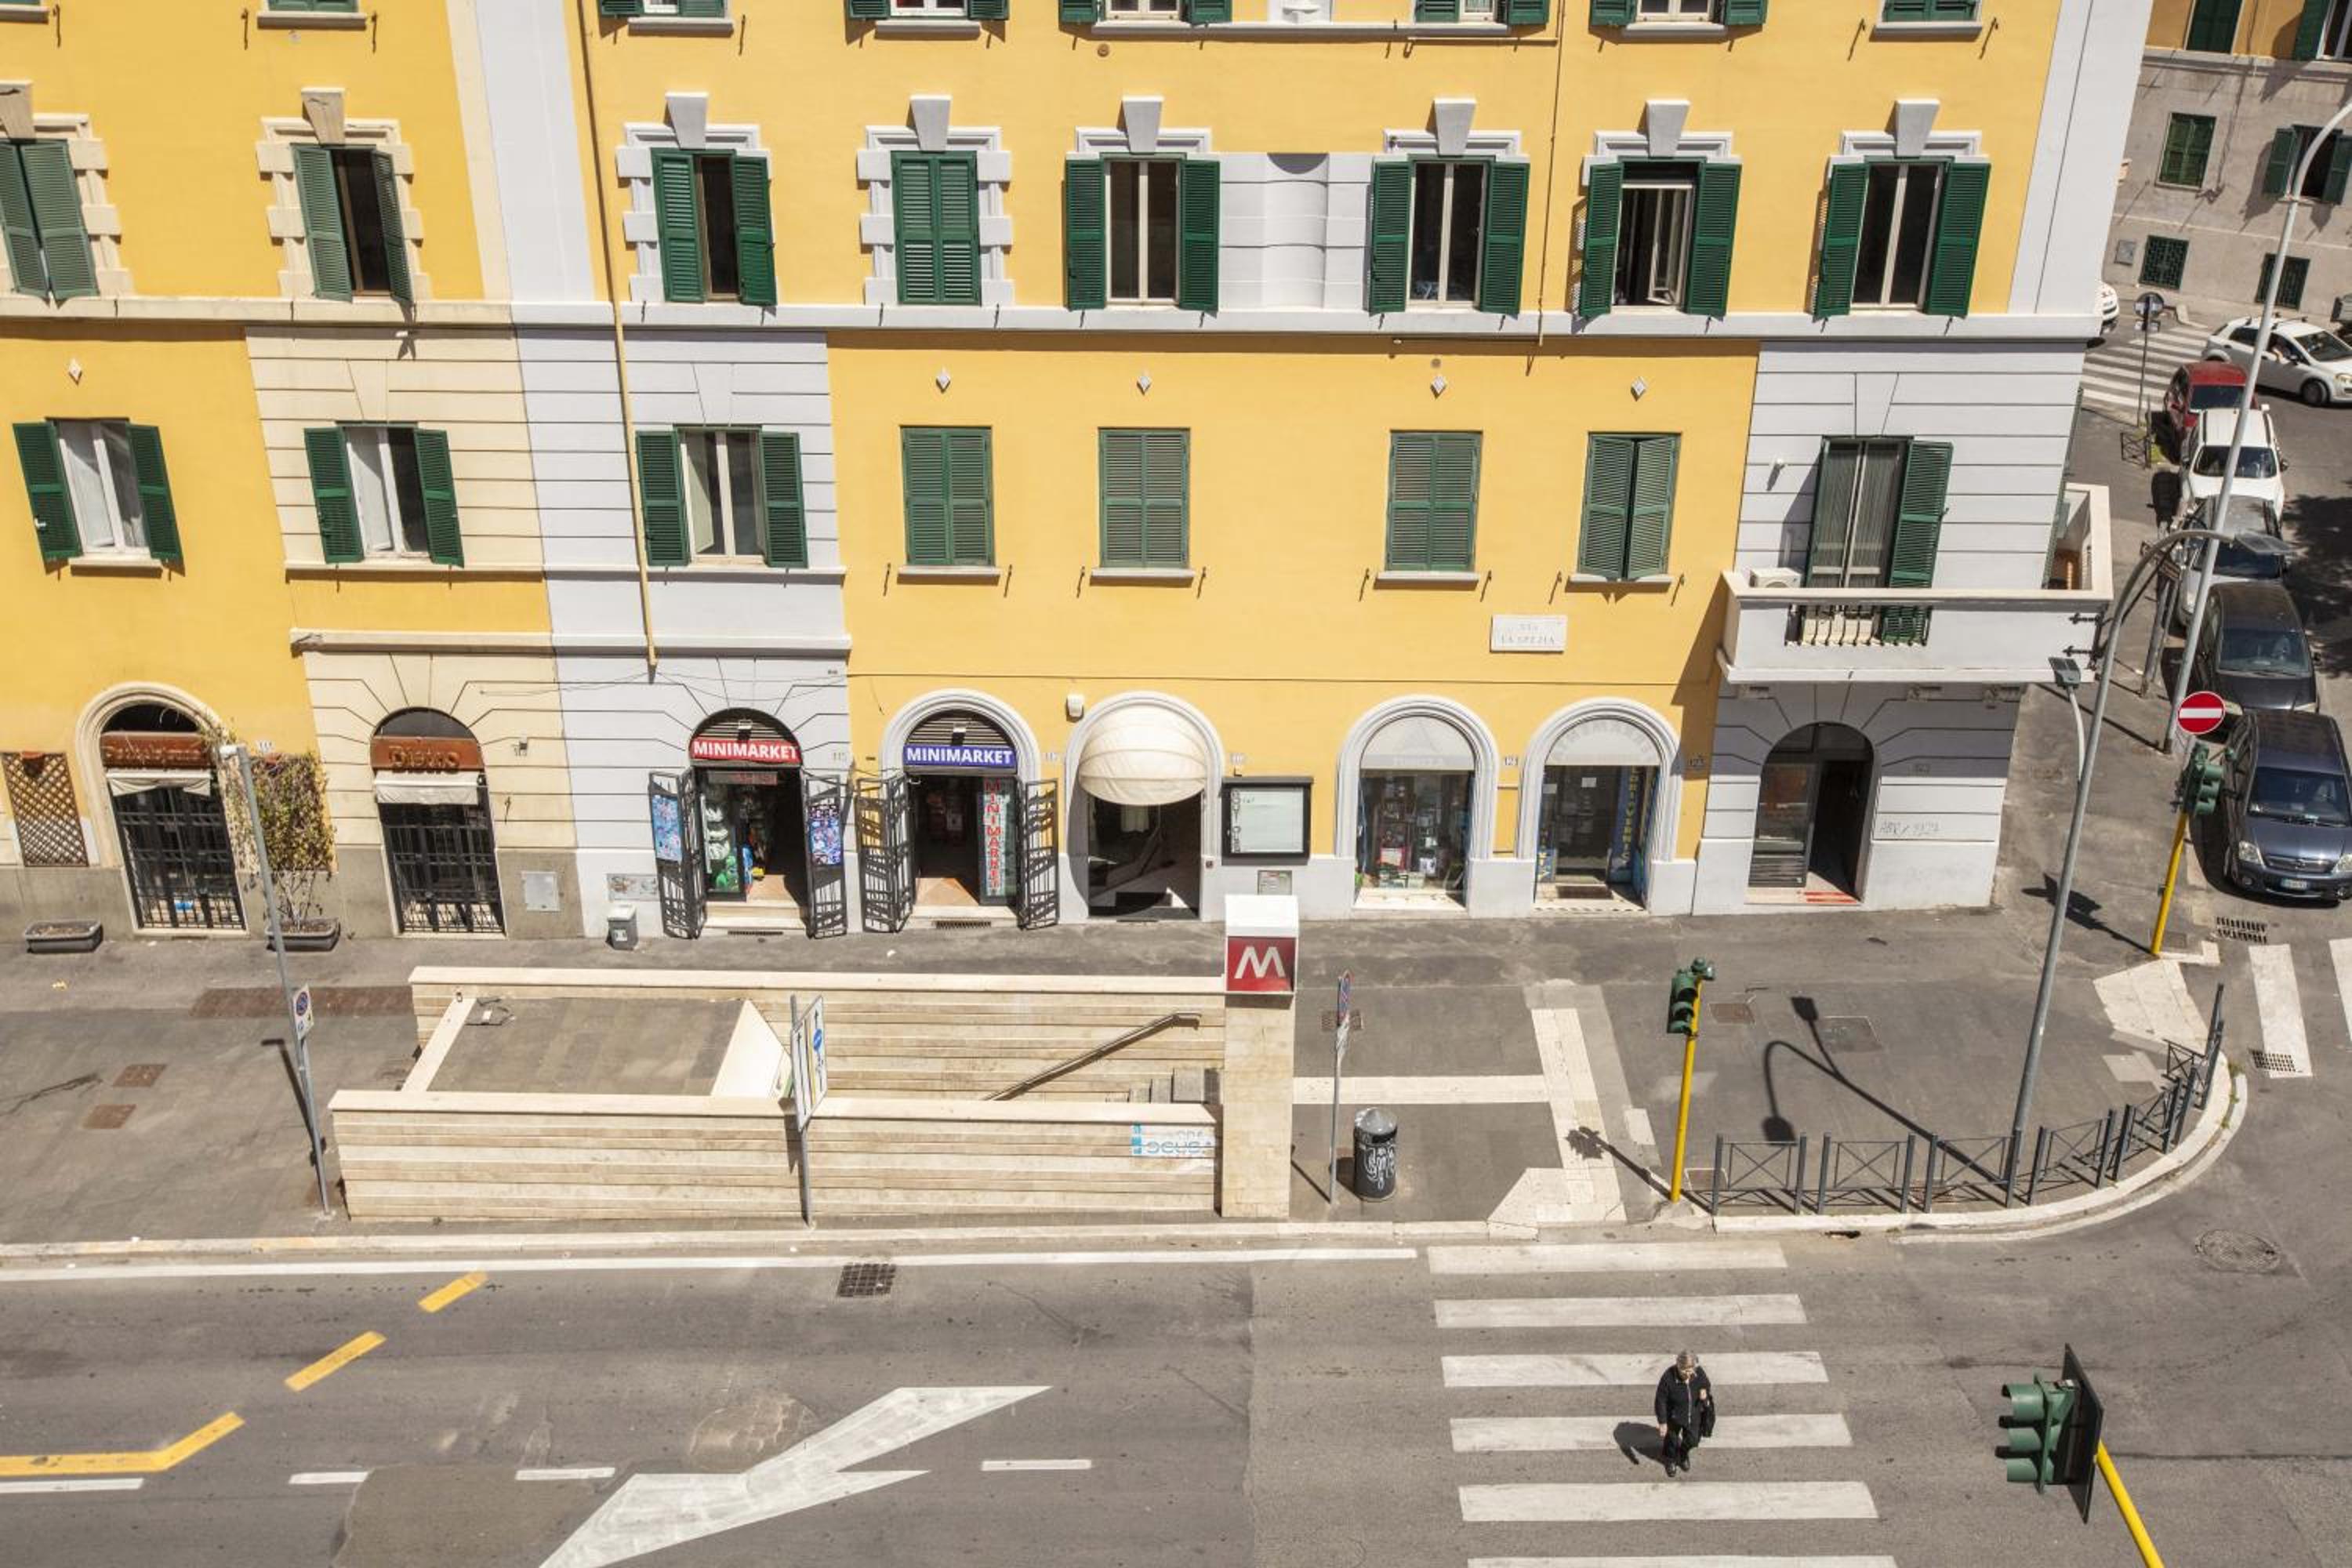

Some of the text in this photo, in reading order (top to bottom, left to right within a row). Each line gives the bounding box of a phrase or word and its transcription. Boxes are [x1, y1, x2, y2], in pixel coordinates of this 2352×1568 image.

[693, 741, 798, 760] MINIMARKET
[906, 747, 1013, 764] MINIMARKET
[984, 778, 1001, 889] MINIMARKET
[1233, 946, 1287, 979] M
